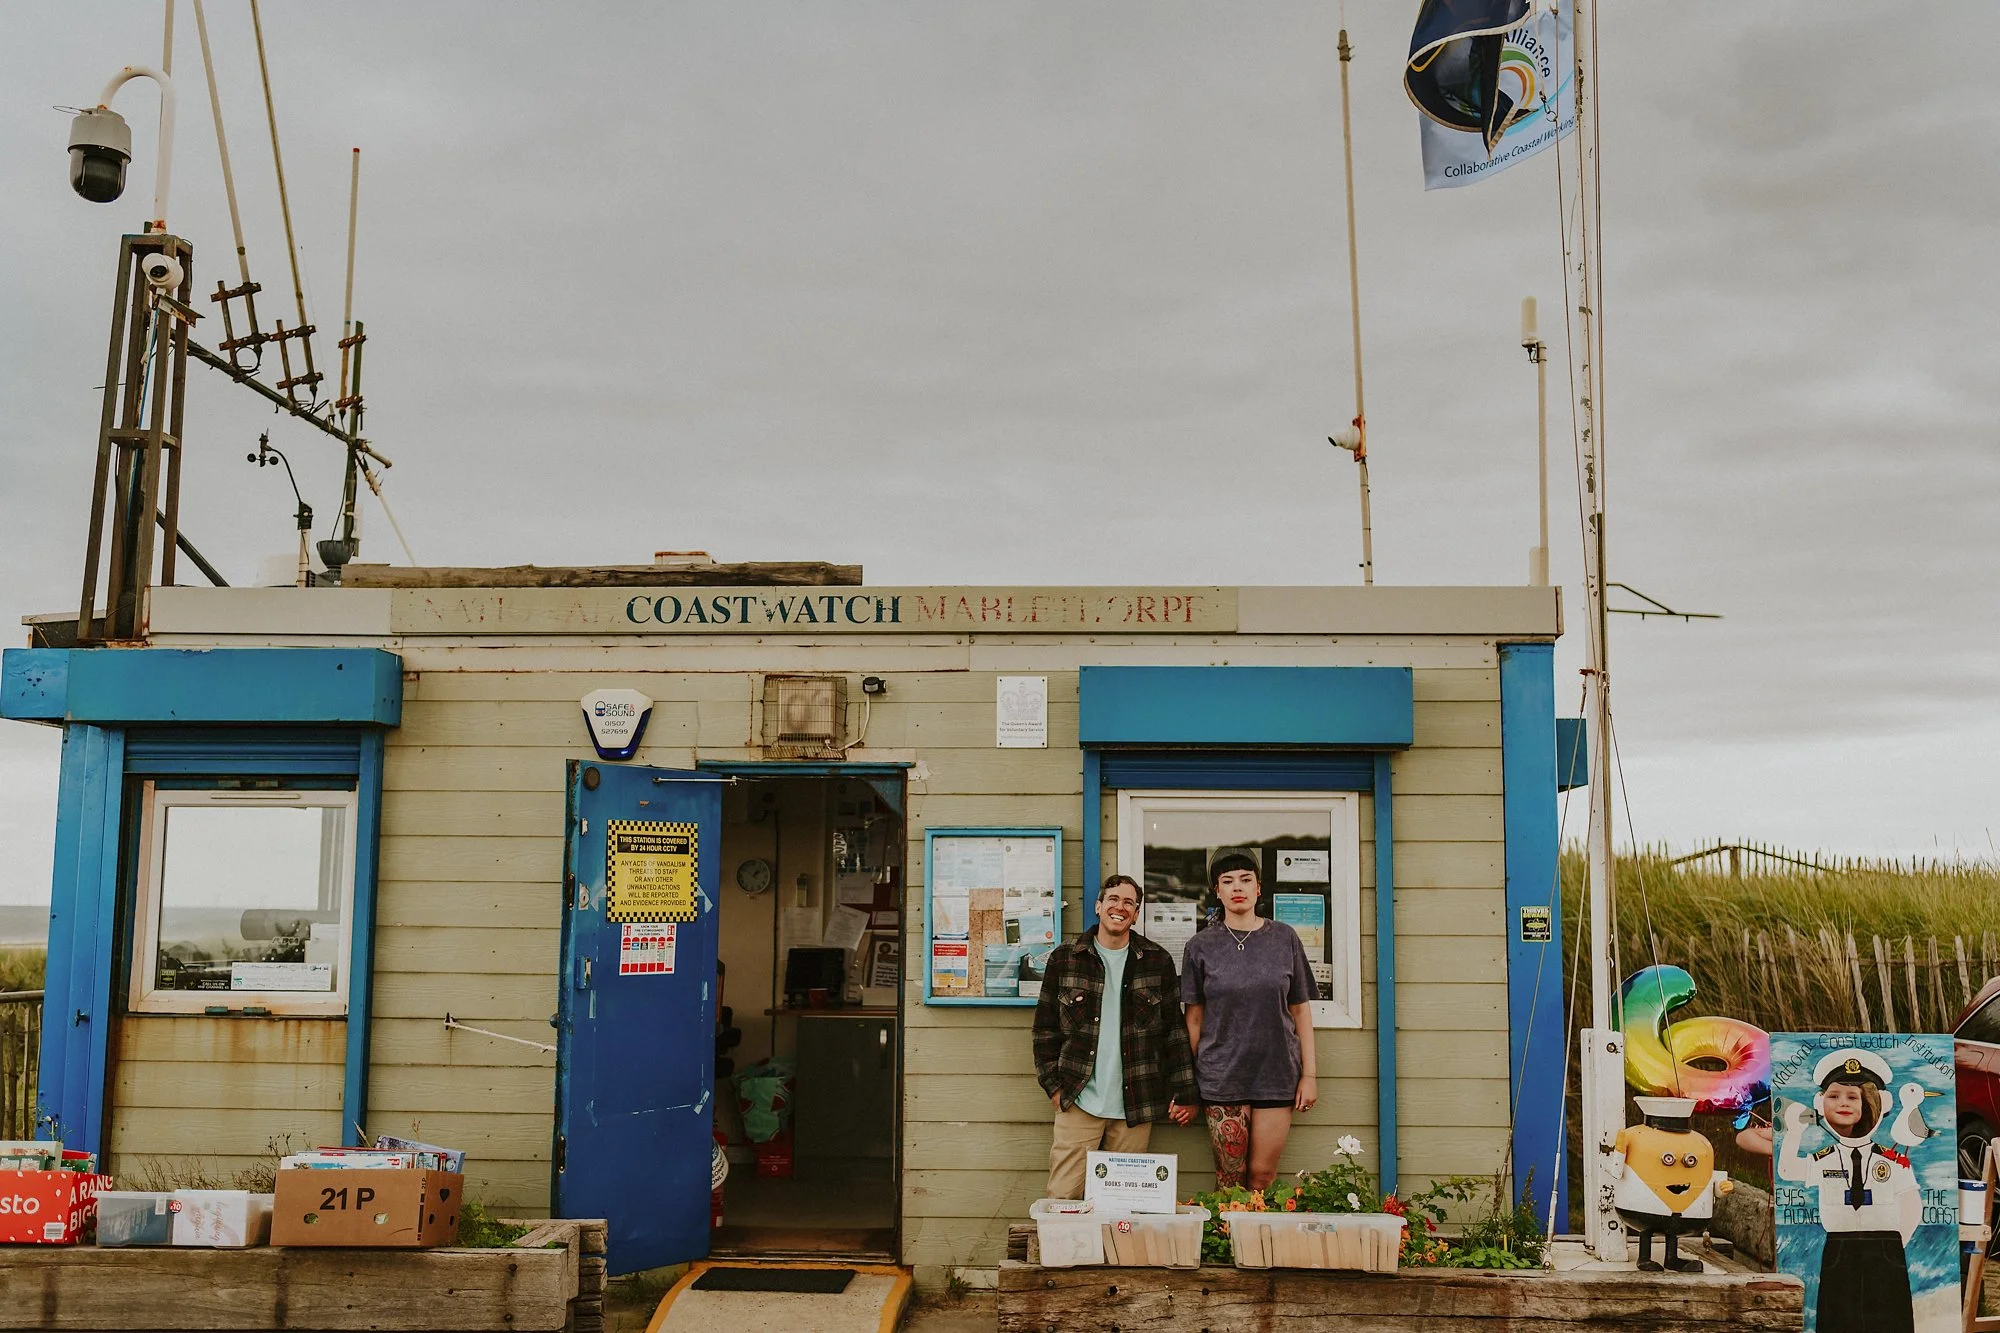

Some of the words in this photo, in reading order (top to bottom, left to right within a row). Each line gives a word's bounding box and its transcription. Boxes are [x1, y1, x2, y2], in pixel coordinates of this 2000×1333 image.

[1504, 28, 1551, 78] Alliance
[1444, 152, 1510, 178] Collaborative
[1511, 133, 1544, 157] Coastal
[626, 594, 902, 625] COASTWATCH
[605, 709, 636, 717] SOUND
[632, 836, 656, 844] STATION
[662, 837, 688, 845] COVERED
[1818, 1034, 1900, 1050] Coastwatch
[1771, 1039, 1817, 1092] National
[1901, 1034, 1956, 1081] Institution
[69, 1186, 78, 1207] A
[1775, 1187, 1806, 1207] EYES
[1923, 1188, 1949, 1207] THE
[1783, 1206, 1821, 1226] ALONG
[1922, 1206, 1959, 1225] COAST
